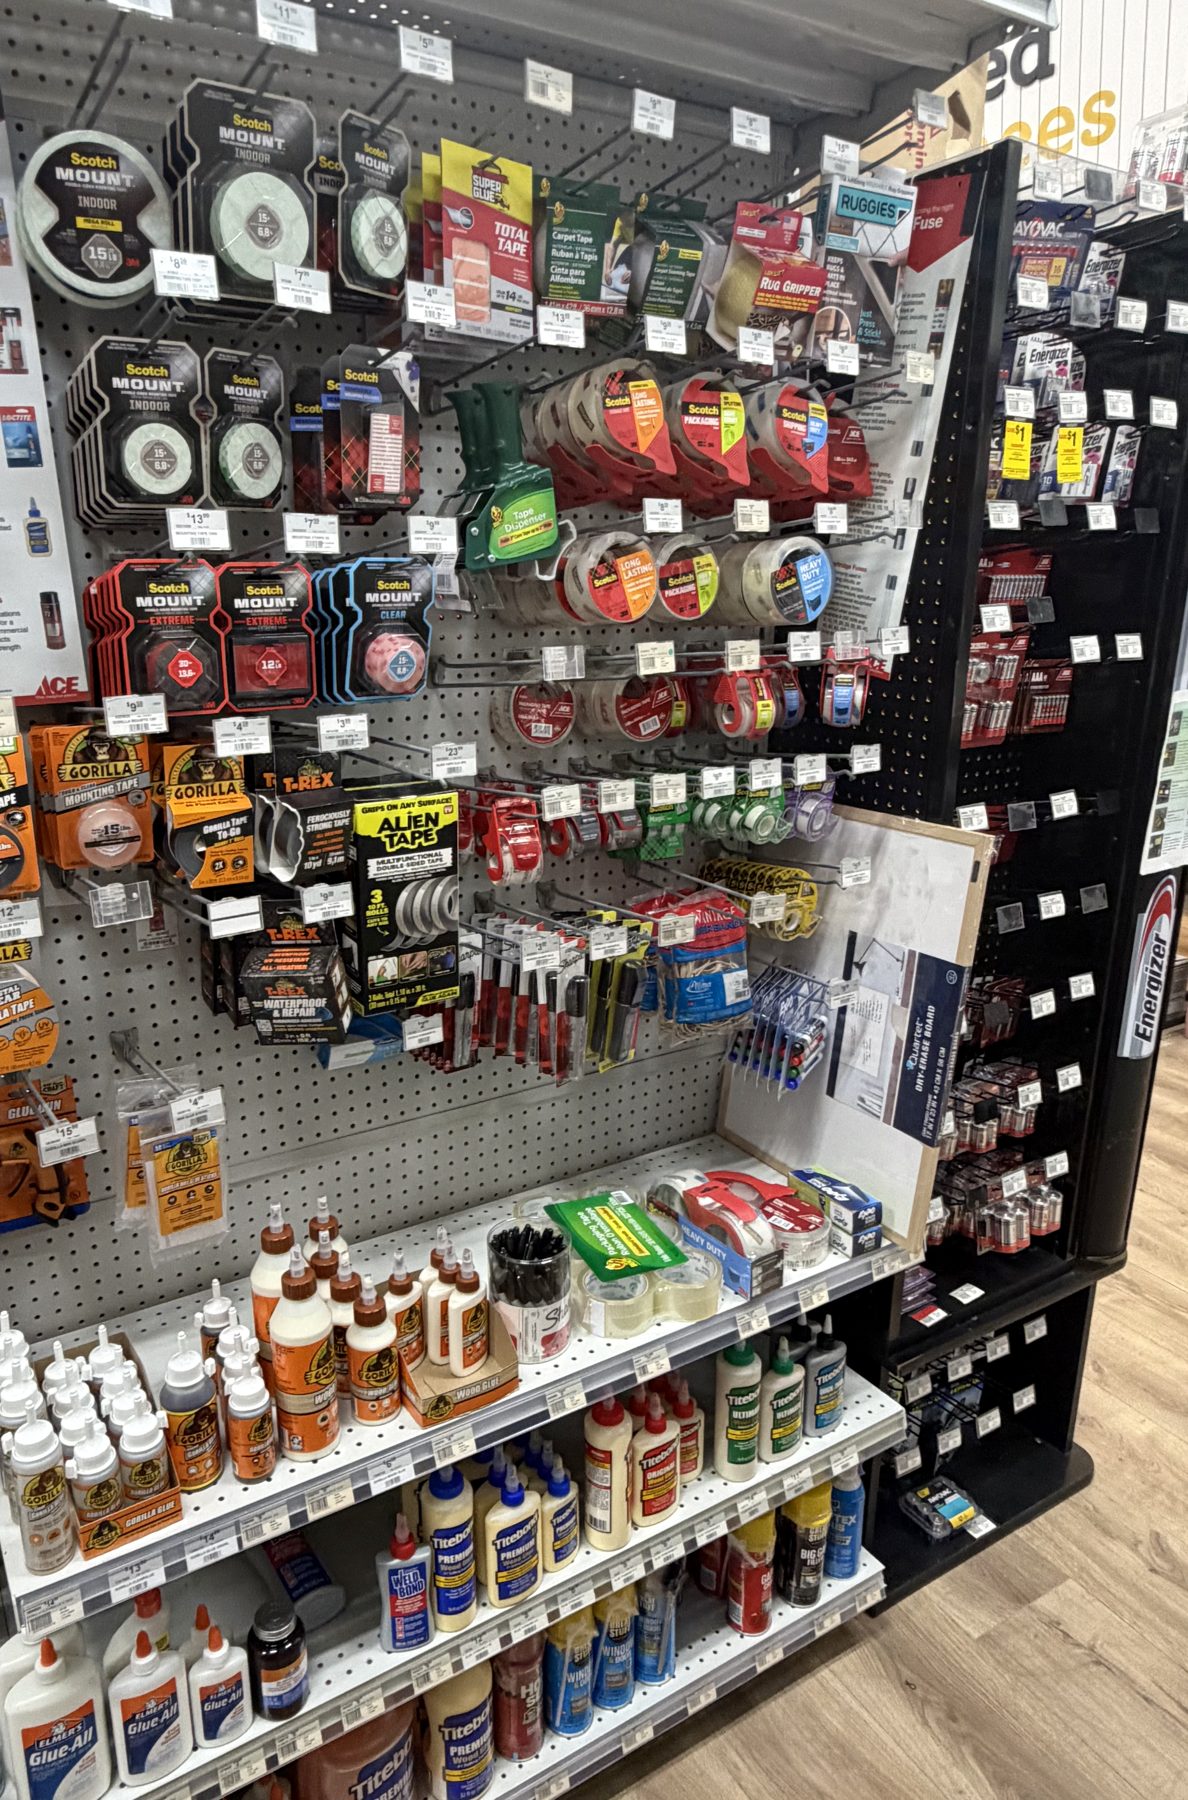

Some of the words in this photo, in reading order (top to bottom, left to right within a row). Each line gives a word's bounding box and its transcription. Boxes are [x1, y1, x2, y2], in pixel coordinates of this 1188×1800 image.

[233, 114, 272, 132] Scotch
[219, 126, 286, 151] MOUNT
[234, 148, 271, 165] INDOOR
[363, 143, 389, 160] Scotch
[71, 152, 117, 170] Scotch
[355, 152, 396, 176] MOUNT
[55, 166, 134, 188] MOUNT
[471, 175, 502, 192] SUPER
[78, 195, 118, 211] INDOOR
[841, 194, 897, 219] RUGGIES
[494, 221, 530, 244] TOTAL
[1013, 217, 1065, 238] AYOVAC
[552, 231, 576, 243] Carpet
[576, 235, 593, 245] Tape
[89, 246, 107, 260] 15
[497, 239, 528, 258] TAPE
[551, 249, 574, 258] Ruban
[580, 251, 598, 262] Tapis
[550, 265, 569, 275] Cinta
[569, 268, 586, 278] para
[1085, 258, 1123, 274] Energizer
[550, 274, 586, 286] Alfombras
[1029, 347, 1070, 365] Energizer
[126, 363, 169, 377] Scotch
[345, 369, 379, 384] Scotch
[112, 377, 185, 392] MOUNT
[232, 375, 259, 386] Scotch
[224, 385, 268, 399] MOUNT
[632, 392, 648, 400] LONG
[129, 399, 170, 412] INDOOR
[233, 403, 260, 414] INDOOR
[604, 395, 631, 408] Scotch
[1, 413, 32, 422] LOCTITE
[688, 404, 719, 416] Scotch
[782, 408, 807, 423] Scotch
[684, 416, 720, 426] PACKAGING
[1015, 424, 1026, 442] $1
[1067, 430, 1077, 447] $1
[513, 508, 534, 521] Tape
[504, 512, 546, 534] Dispenser
[620, 557, 641, 571] LONG
[622, 562, 654, 580] LASTING
[800, 558, 822, 574] HEAVY
[593, 573, 618, 588] Scotch
[668, 574, 695, 587] Scotch
[801, 569, 820, 582] DUTY
[148, 582, 190, 594] Scotch
[246, 585, 284, 596] Scotch
[377, 580, 410, 591] Scotch
[775, 576, 797, 592] Scotch
[136, 596, 205, 608] MOUNT
[234, 597, 297, 609] MOUNT
[365, 592, 421, 603] MOUNT
[149, 615, 196, 625] EXTREME
[245, 617, 288, 626] EXTREME
[380, 610, 407, 619] CLEAR
[261, 660, 274, 670] 12
[1031, 672, 1043, 682] AAA
[35, 675, 79, 696] ACE
[70, 763, 133, 779] GORILLA
[282, 771, 335, 793] T-REX
[64, 784, 115, 807] MOUNTING
[116, 777, 139, 792] TAPE
[174, 782, 237, 800] GORILLA
[361, 805, 386, 814] GRIPS
[386, 803, 399, 811] ON
[399, 801, 416, 810] ANY
[306, 809, 351, 824] FEROCIOUSLY
[377, 811, 440, 835] ALIEN
[103, 823, 120, 835] 15
[203, 820, 231, 835] GORILLA
[231, 815, 248, 828] TAPE
[305, 820, 333, 833] STRONG
[333, 817, 351, 828] TAPE
[217, 827, 241, 840] TO-GO
[385, 828, 438, 852] TAPE
[376, 851, 444, 866] MULTIFUNCTIONAL
[370, 888, 383, 904] 3
[774, 886, 798, 895] Scotch
[265, 927, 320, 941] T-REX
[264, 986, 305, 996] T-REX
[1134, 932, 1167, 1043] Energizer
[11, 998, 35, 1016] TAPE
[263, 997, 328, 1009] WATERPROOF
[272, 1009, 280, 1017] &
[281, 1007, 317, 1018] REPAIR
[909, 1018, 924, 1066] Quartet
[915, 1040, 931, 1093] DRY-ERASE
[923, 1004, 936, 1041] BOARD
[938, 1046, 946, 1058] CM
[171, 1154, 203, 1170] GORILLA
[681, 1223, 706, 1248] HEAVY
[705, 1241, 728, 1262] DUTY
[456, 1385, 481, 1400] WOOD
[481, 1376, 500, 1393] GLUE
[125, 1508, 157, 1528] GORILLA
[157, 1500, 176, 1516] GLUE
[500, 1540, 536, 1561] PREMIUM
[801, 1549, 817, 1560] BIG
[391, 1569, 420, 1589] WELD
[397, 1577, 426, 1599] BOND
[203, 1687, 243, 1712] Glue-All
[128, 1702, 178, 1736] Glue-All
[135, 1701, 171, 1721] ELMER'S
[38, 1721, 83, 1748] ELMER'S
[29, 1727, 93, 1767] Glue-All
